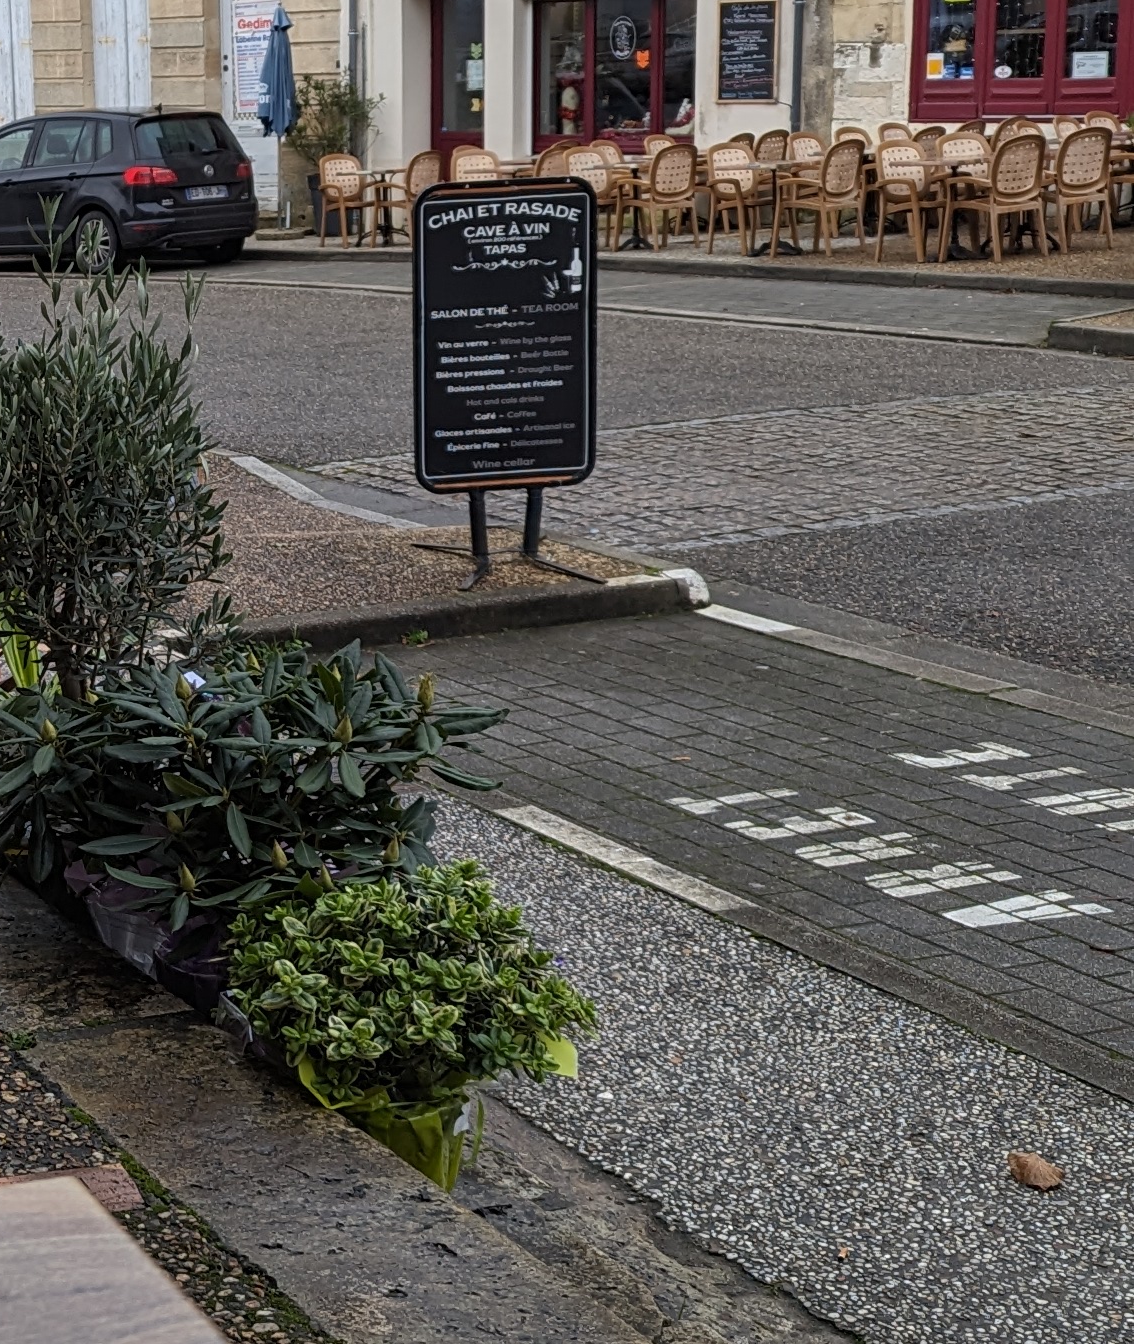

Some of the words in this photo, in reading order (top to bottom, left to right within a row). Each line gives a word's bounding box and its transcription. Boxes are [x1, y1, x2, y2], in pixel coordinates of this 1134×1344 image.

[238, 17, 274, 29] Gedim
[429, 207, 473, 228] CHAI
[478, 204, 501, 217] ET
[505, 202, 581, 221] RASADE
[464, 225, 506, 237] CAVE
[509, 221, 520, 235] À
[524, 223, 550, 233] VIN
[484, 244, 526, 255] TAPAS
[431, 309, 468, 319] SALON
[470, 308, 484, 317] DE
[487, 304, 509, 315] THÉ
[521, 304, 543, 313] TEA
[545, 303, 579, 311] ROOM
[522, 337, 533, 345] by
[465, 368, 505, 378] pressions
[486, 382, 521, 391] chaudes
[472, 459, 501, 468] Wine
[504, 458, 536, 467] cellar
